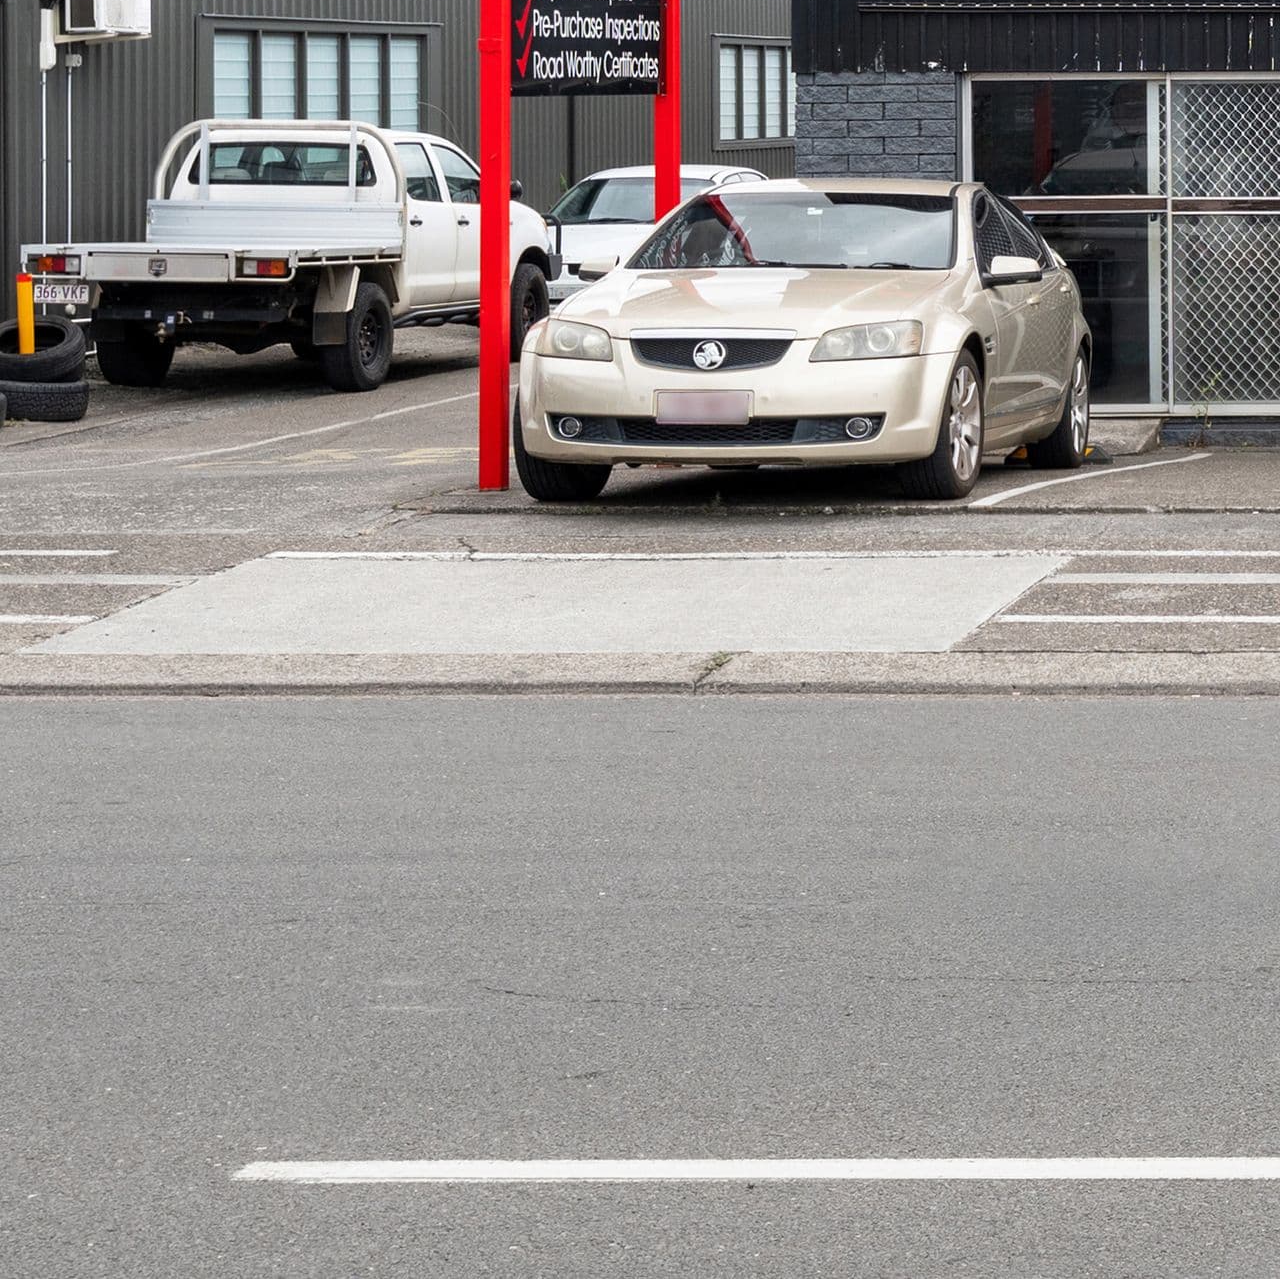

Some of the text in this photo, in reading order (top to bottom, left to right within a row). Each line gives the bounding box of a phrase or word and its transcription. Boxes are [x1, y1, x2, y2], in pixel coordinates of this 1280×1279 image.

[533, 9, 660, 45] Pre-Purchase Inspections
[533, 50, 659, 83] Road Worthy Certificates
